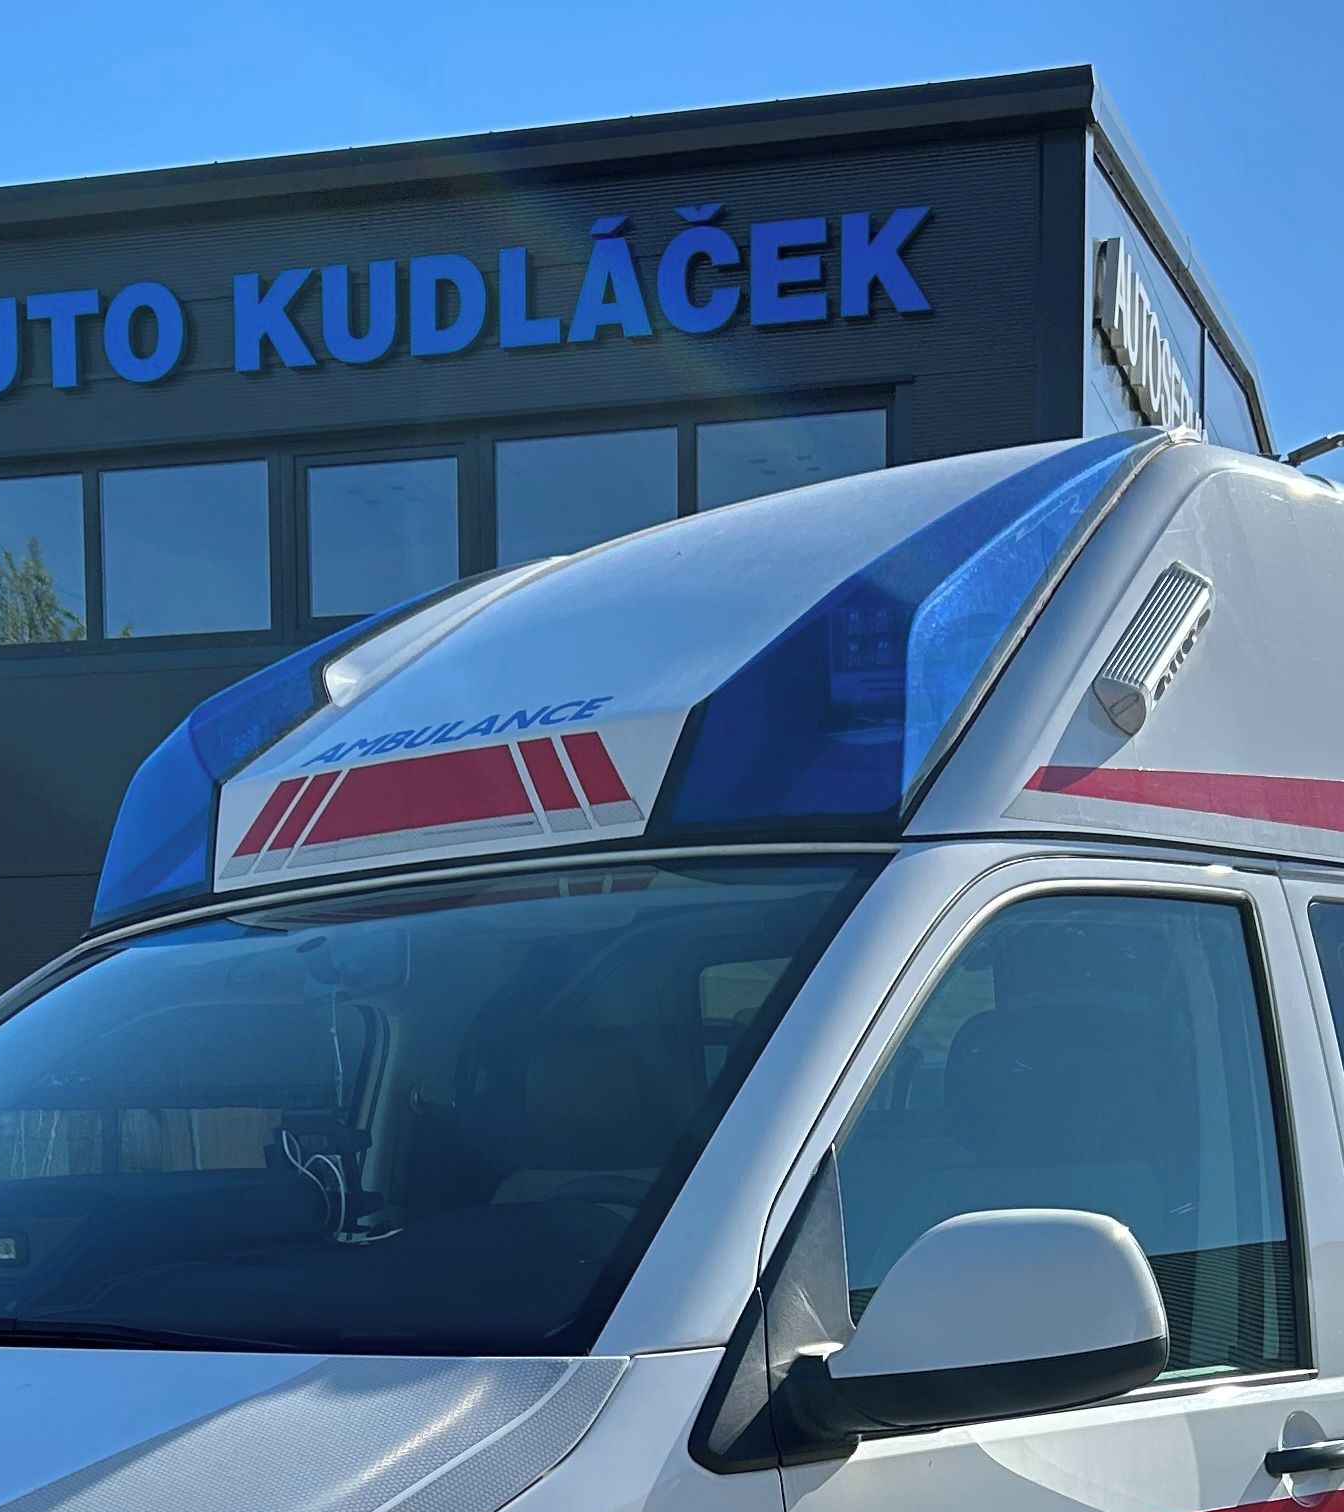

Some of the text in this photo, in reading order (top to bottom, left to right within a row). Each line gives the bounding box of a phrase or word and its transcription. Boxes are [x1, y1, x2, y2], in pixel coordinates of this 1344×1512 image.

[232, 203, 933, 373] KUDLÁČEK
[1111, 236, 1209, 443] AUTOSE
[302, 695, 614, 768] AMBULANCE
